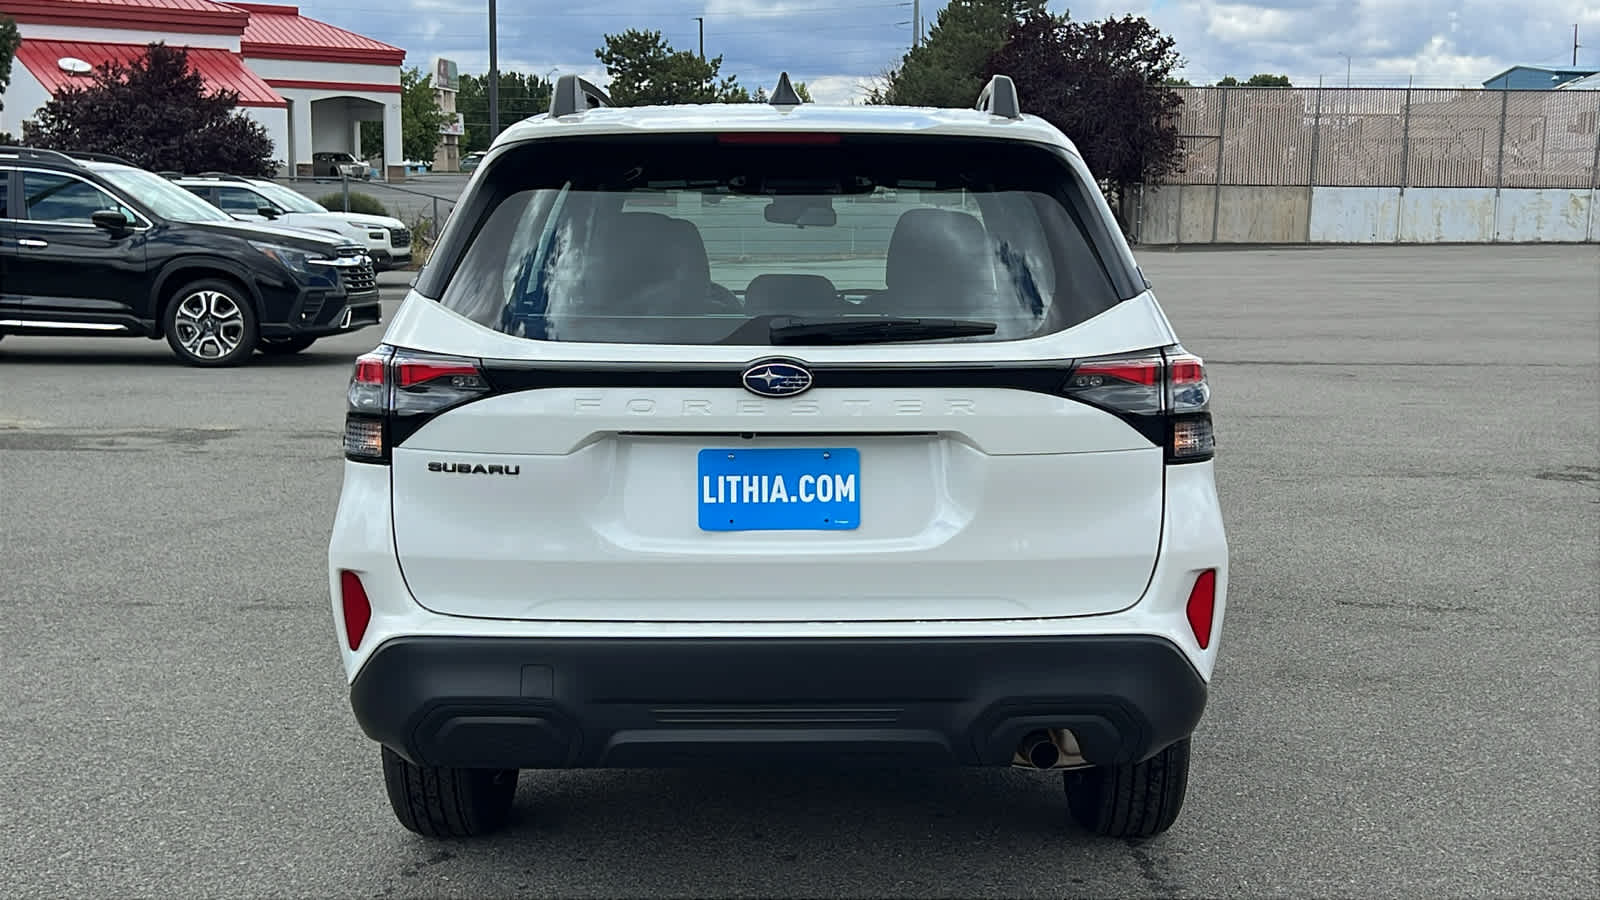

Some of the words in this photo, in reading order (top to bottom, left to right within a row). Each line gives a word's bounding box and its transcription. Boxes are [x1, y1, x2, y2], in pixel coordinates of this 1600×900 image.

[573, 398, 977, 416] FORESTER
[427, 461, 520, 475] SUBARU
[703, 474, 856, 503] LITHIA.COM
